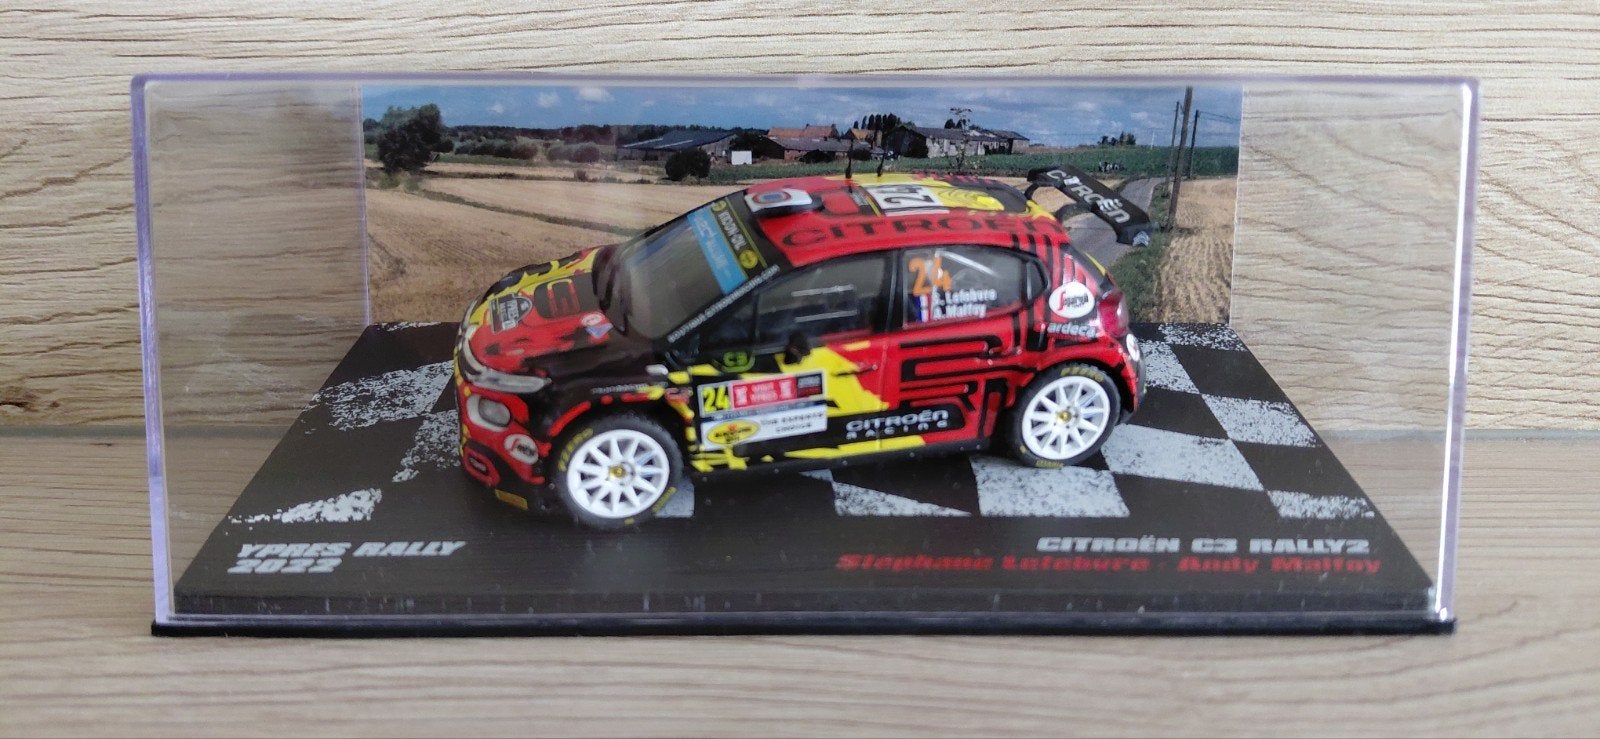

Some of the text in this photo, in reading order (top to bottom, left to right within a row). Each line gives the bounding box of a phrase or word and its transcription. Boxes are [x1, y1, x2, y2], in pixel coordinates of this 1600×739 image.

[908, 257, 952, 295] 24
[702, 385, 731, 412] 24
[237, 541, 467, 558] YPRES RALLY
[1036, 535, 1370, 553] CITROËN C3 RALLY2
[227, 557, 342, 573] 2022
[1177, 556, 1260, 573] Andy
[1270, 556, 1382, 573] Malfoy
